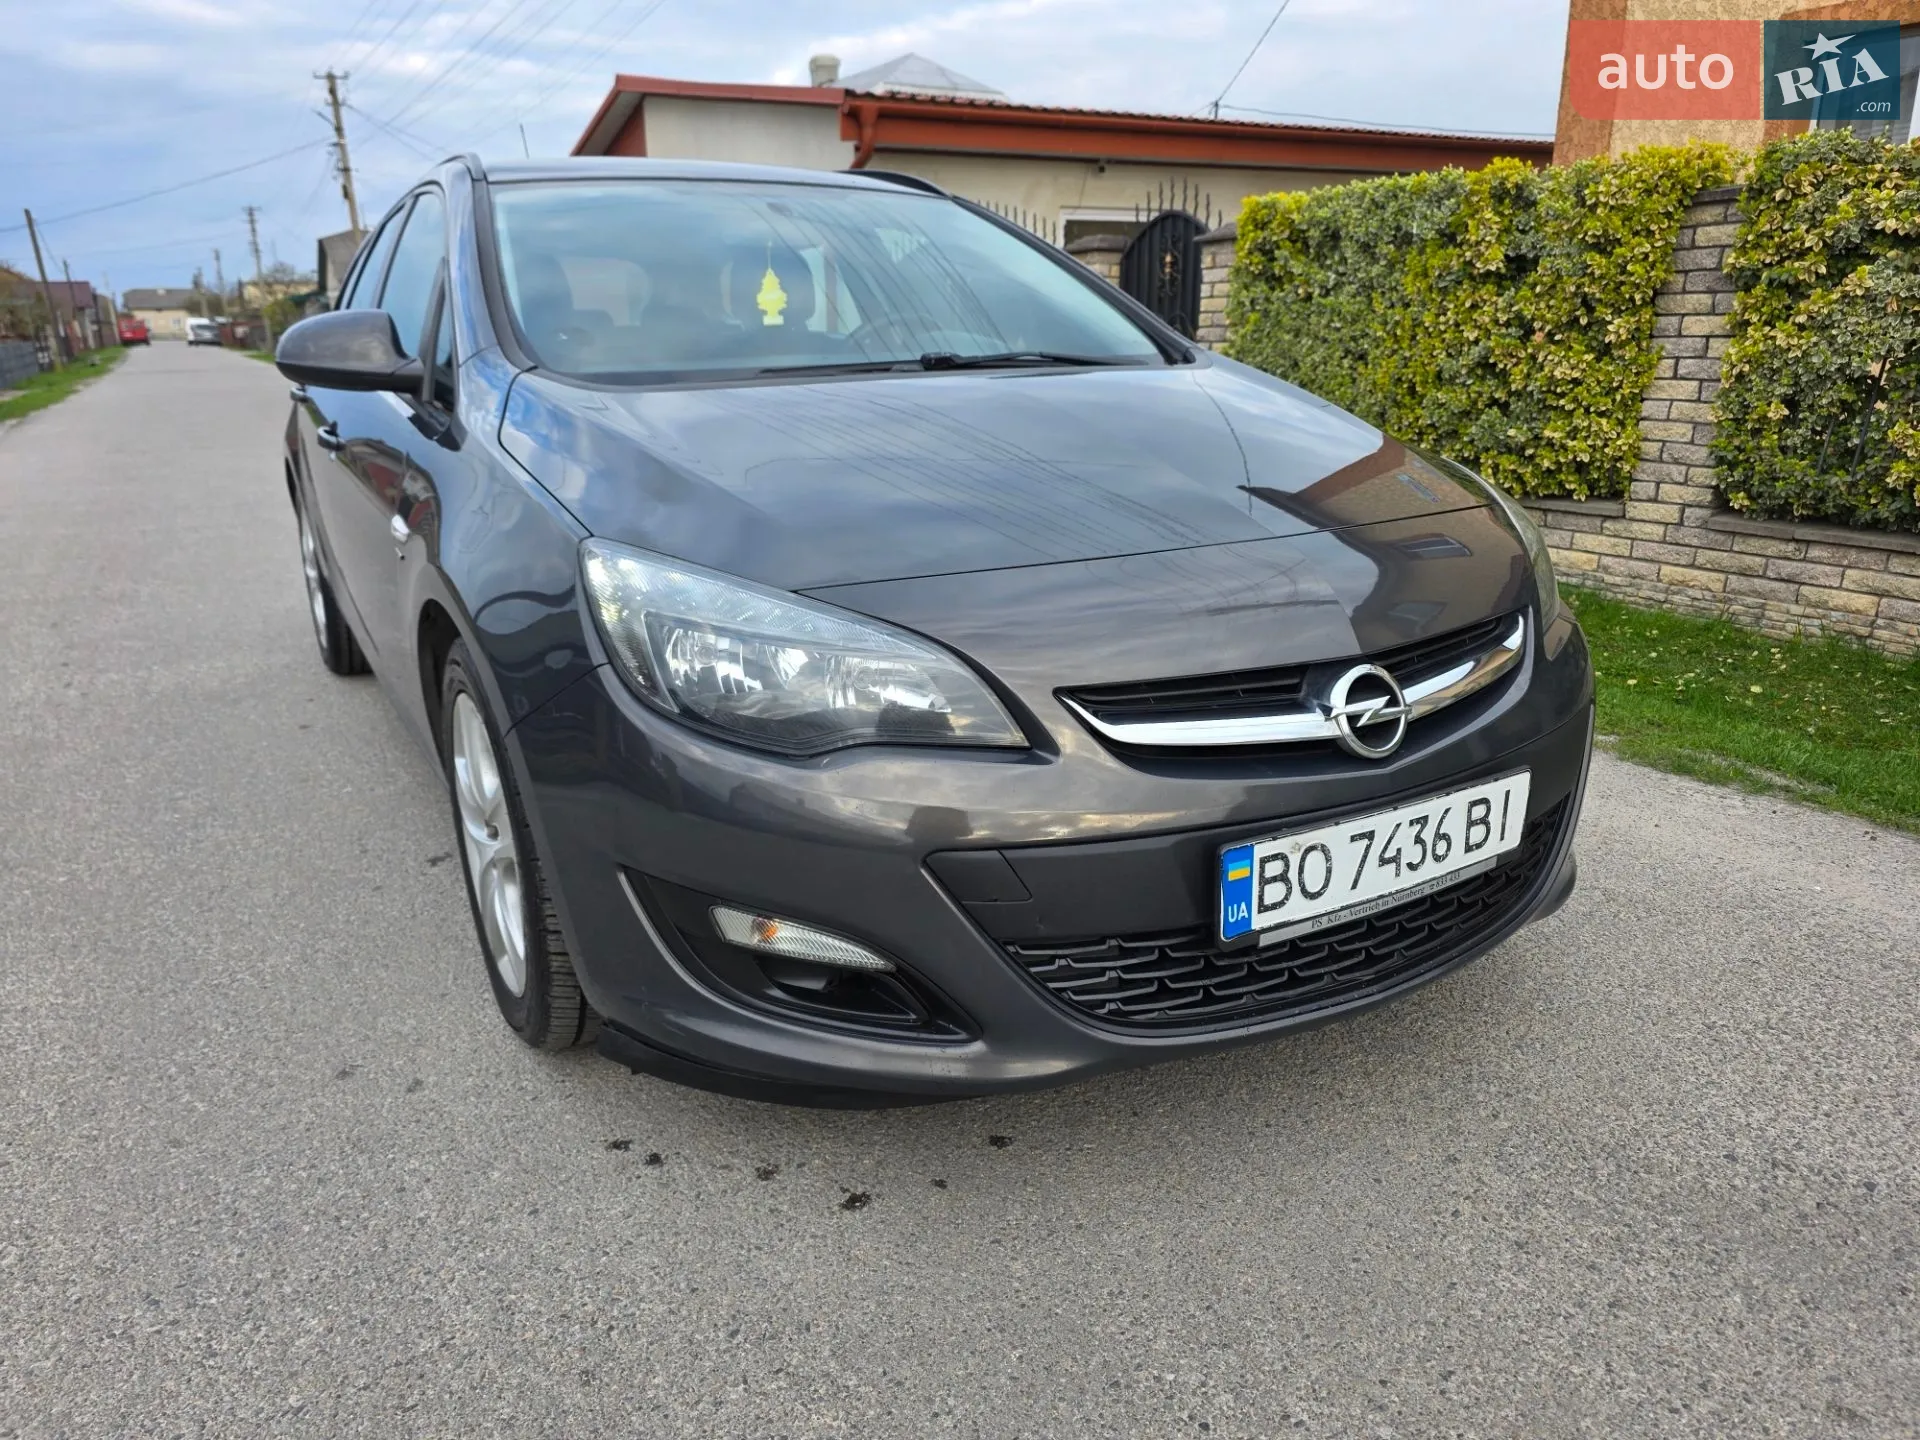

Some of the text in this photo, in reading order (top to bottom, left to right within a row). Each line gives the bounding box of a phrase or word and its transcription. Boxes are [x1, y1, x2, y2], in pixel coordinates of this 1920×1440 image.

[1257, 789, 1511, 914] BO 7436 BI
[1228, 901, 1249, 923] UA
